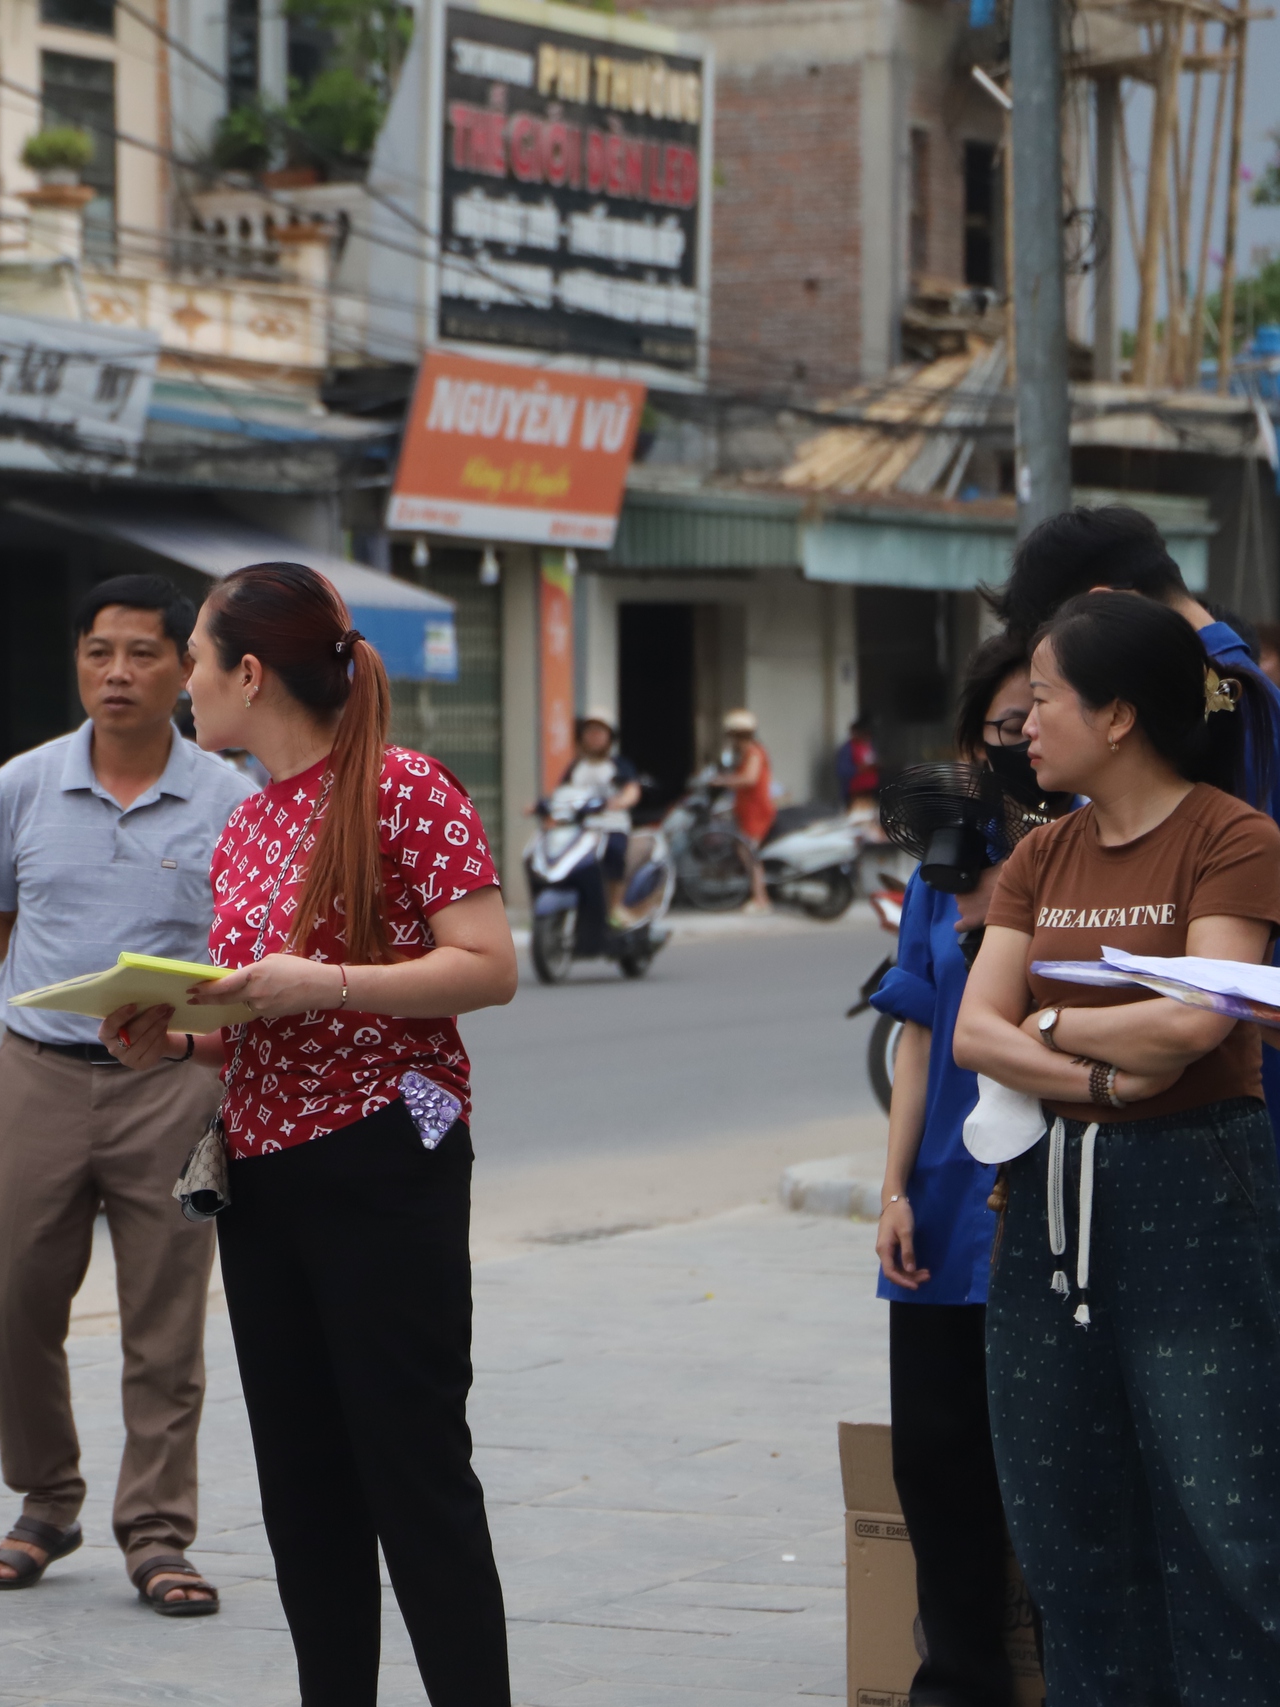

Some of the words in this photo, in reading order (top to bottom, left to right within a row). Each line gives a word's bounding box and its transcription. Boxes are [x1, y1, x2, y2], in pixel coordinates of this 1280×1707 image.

[647, 144, 698, 208] LED
[1036, 903, 1176, 929] BREAKFATNE
[858, 1523, 880, 1535] CODE
